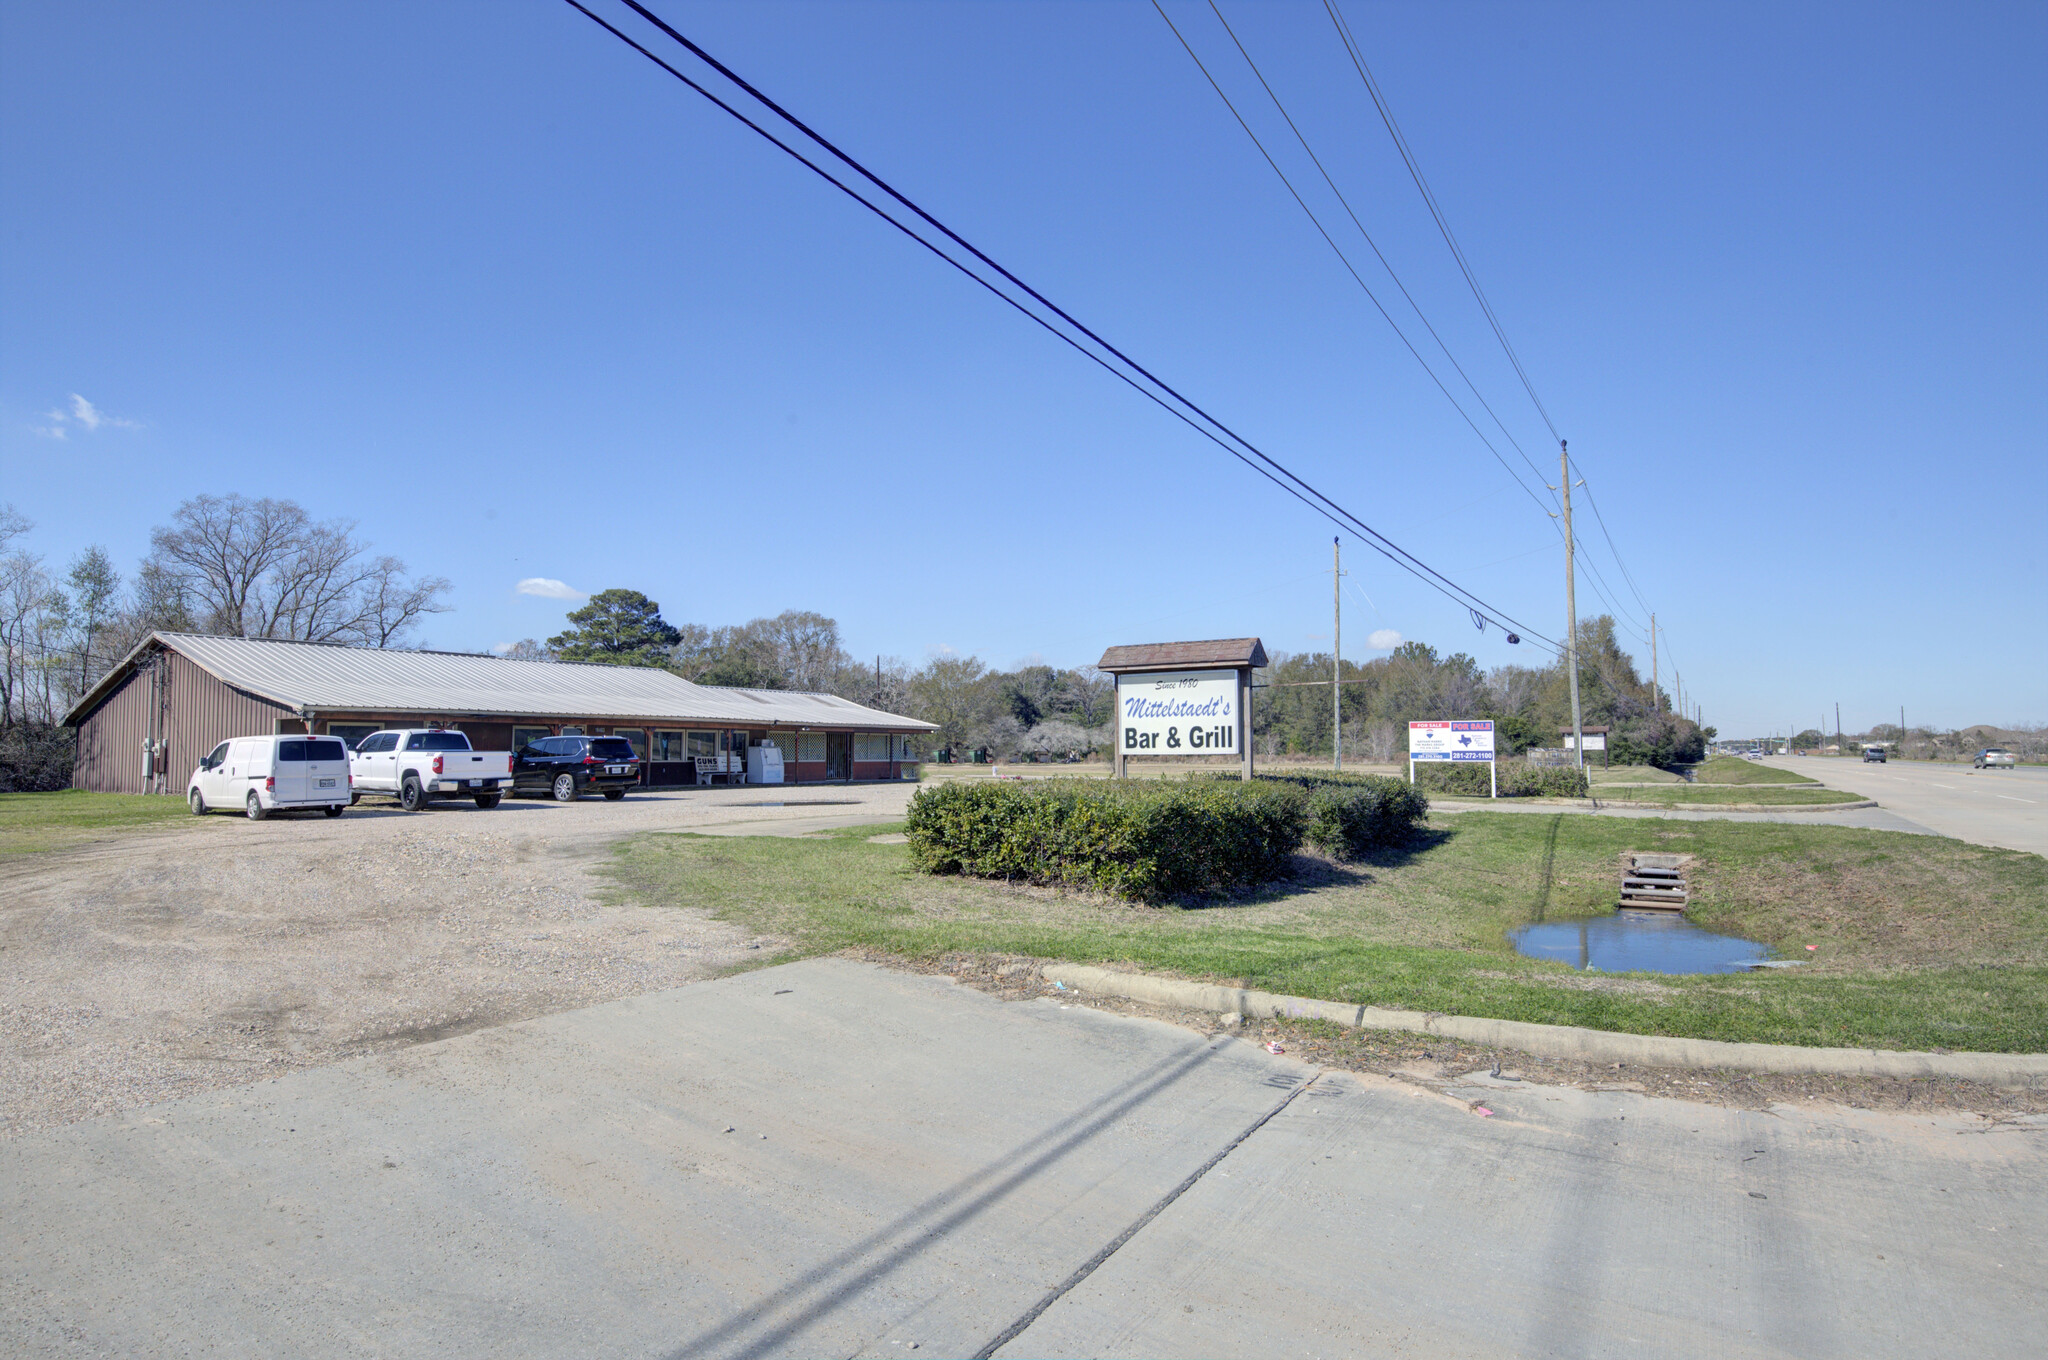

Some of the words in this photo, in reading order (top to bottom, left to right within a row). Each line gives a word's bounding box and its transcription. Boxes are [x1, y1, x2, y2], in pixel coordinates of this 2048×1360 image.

[1155, 680, 1176, 690] Since
[1178, 678, 1199, 688] 1980
[1125, 695, 1231, 719] Mittelstaedt's
[1125, 727, 1160, 749] Bar
[1166, 726, 1181, 749] &
[1189, 725, 1233, 748] Grill
